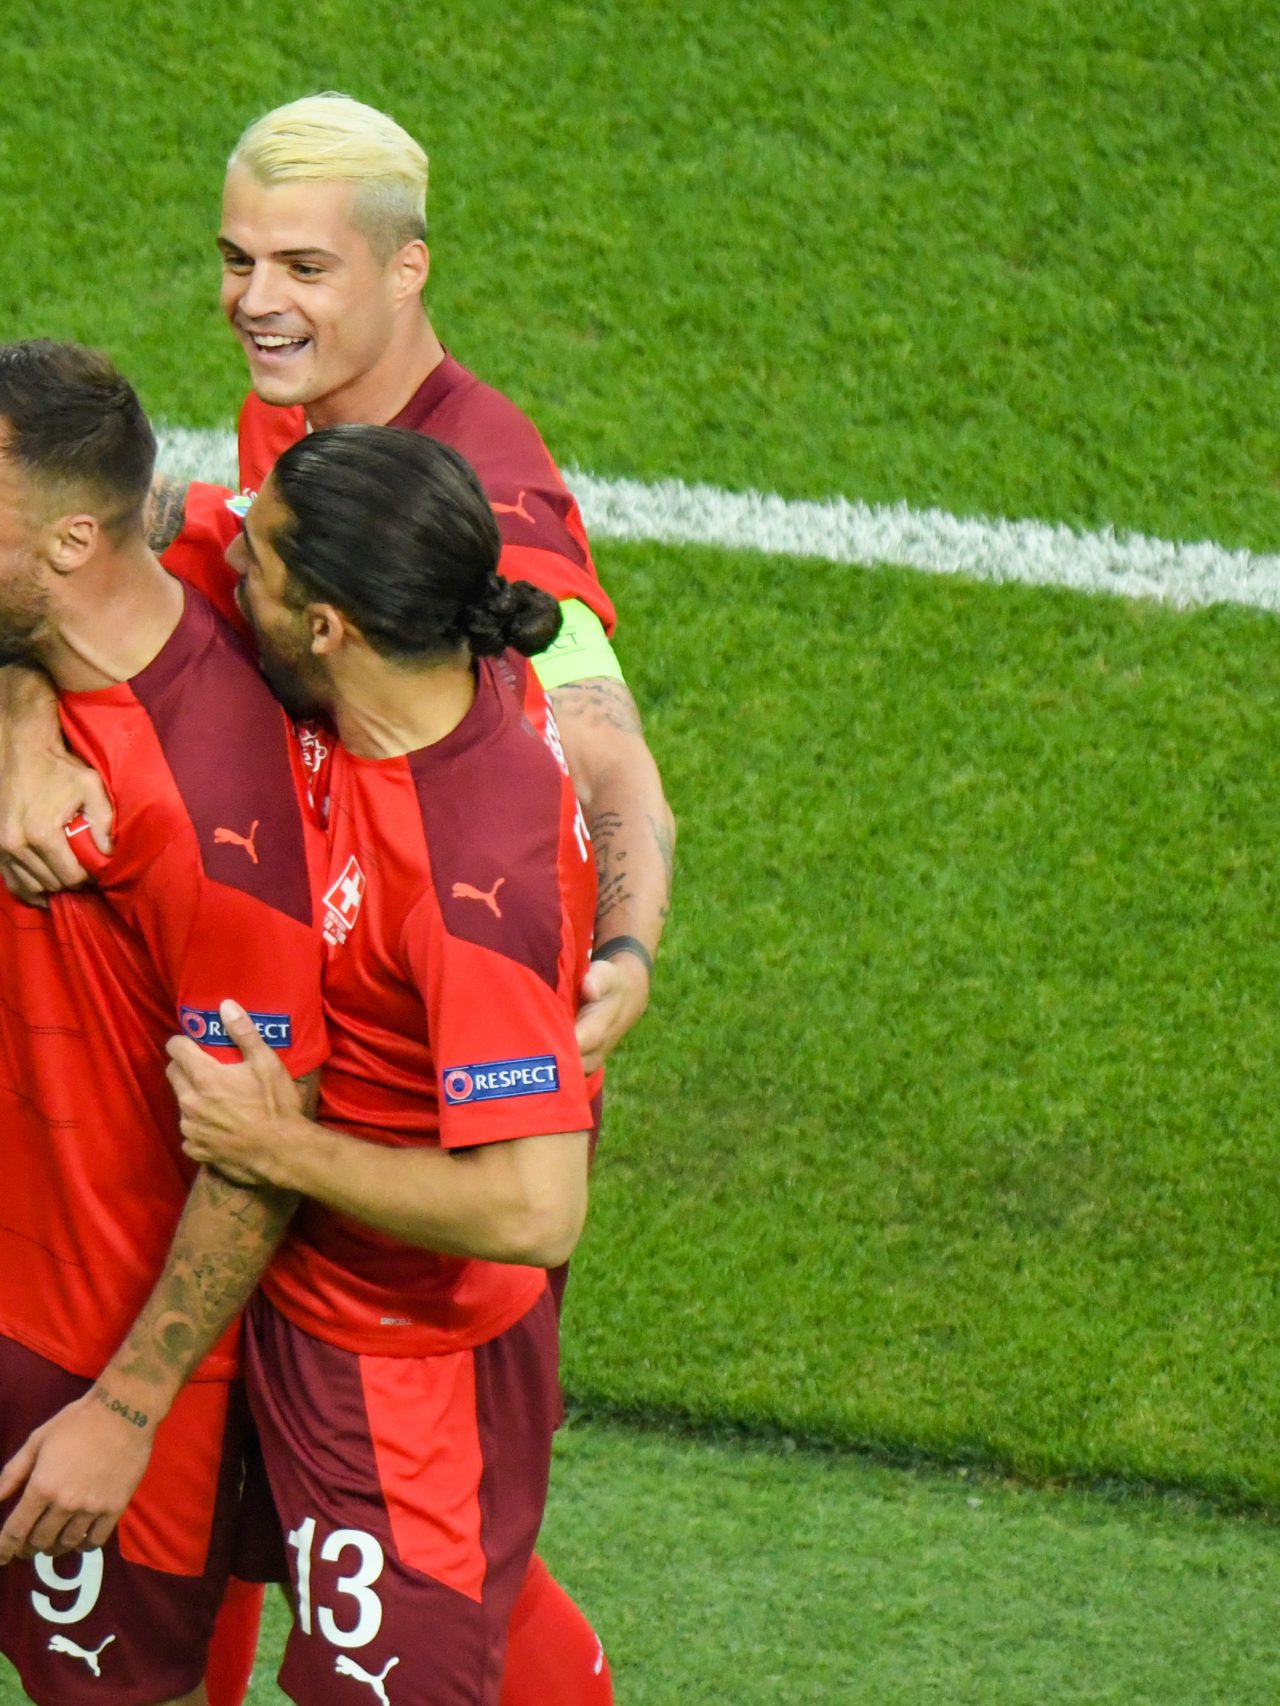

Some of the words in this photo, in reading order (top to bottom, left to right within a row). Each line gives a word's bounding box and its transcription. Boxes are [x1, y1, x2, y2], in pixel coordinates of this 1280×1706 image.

[209, 1021, 290, 1039] RECT
[475, 1065, 557, 1090] RESPECT
[31, 1547, 104, 1625] 9
[287, 1517, 385, 1648] 13
